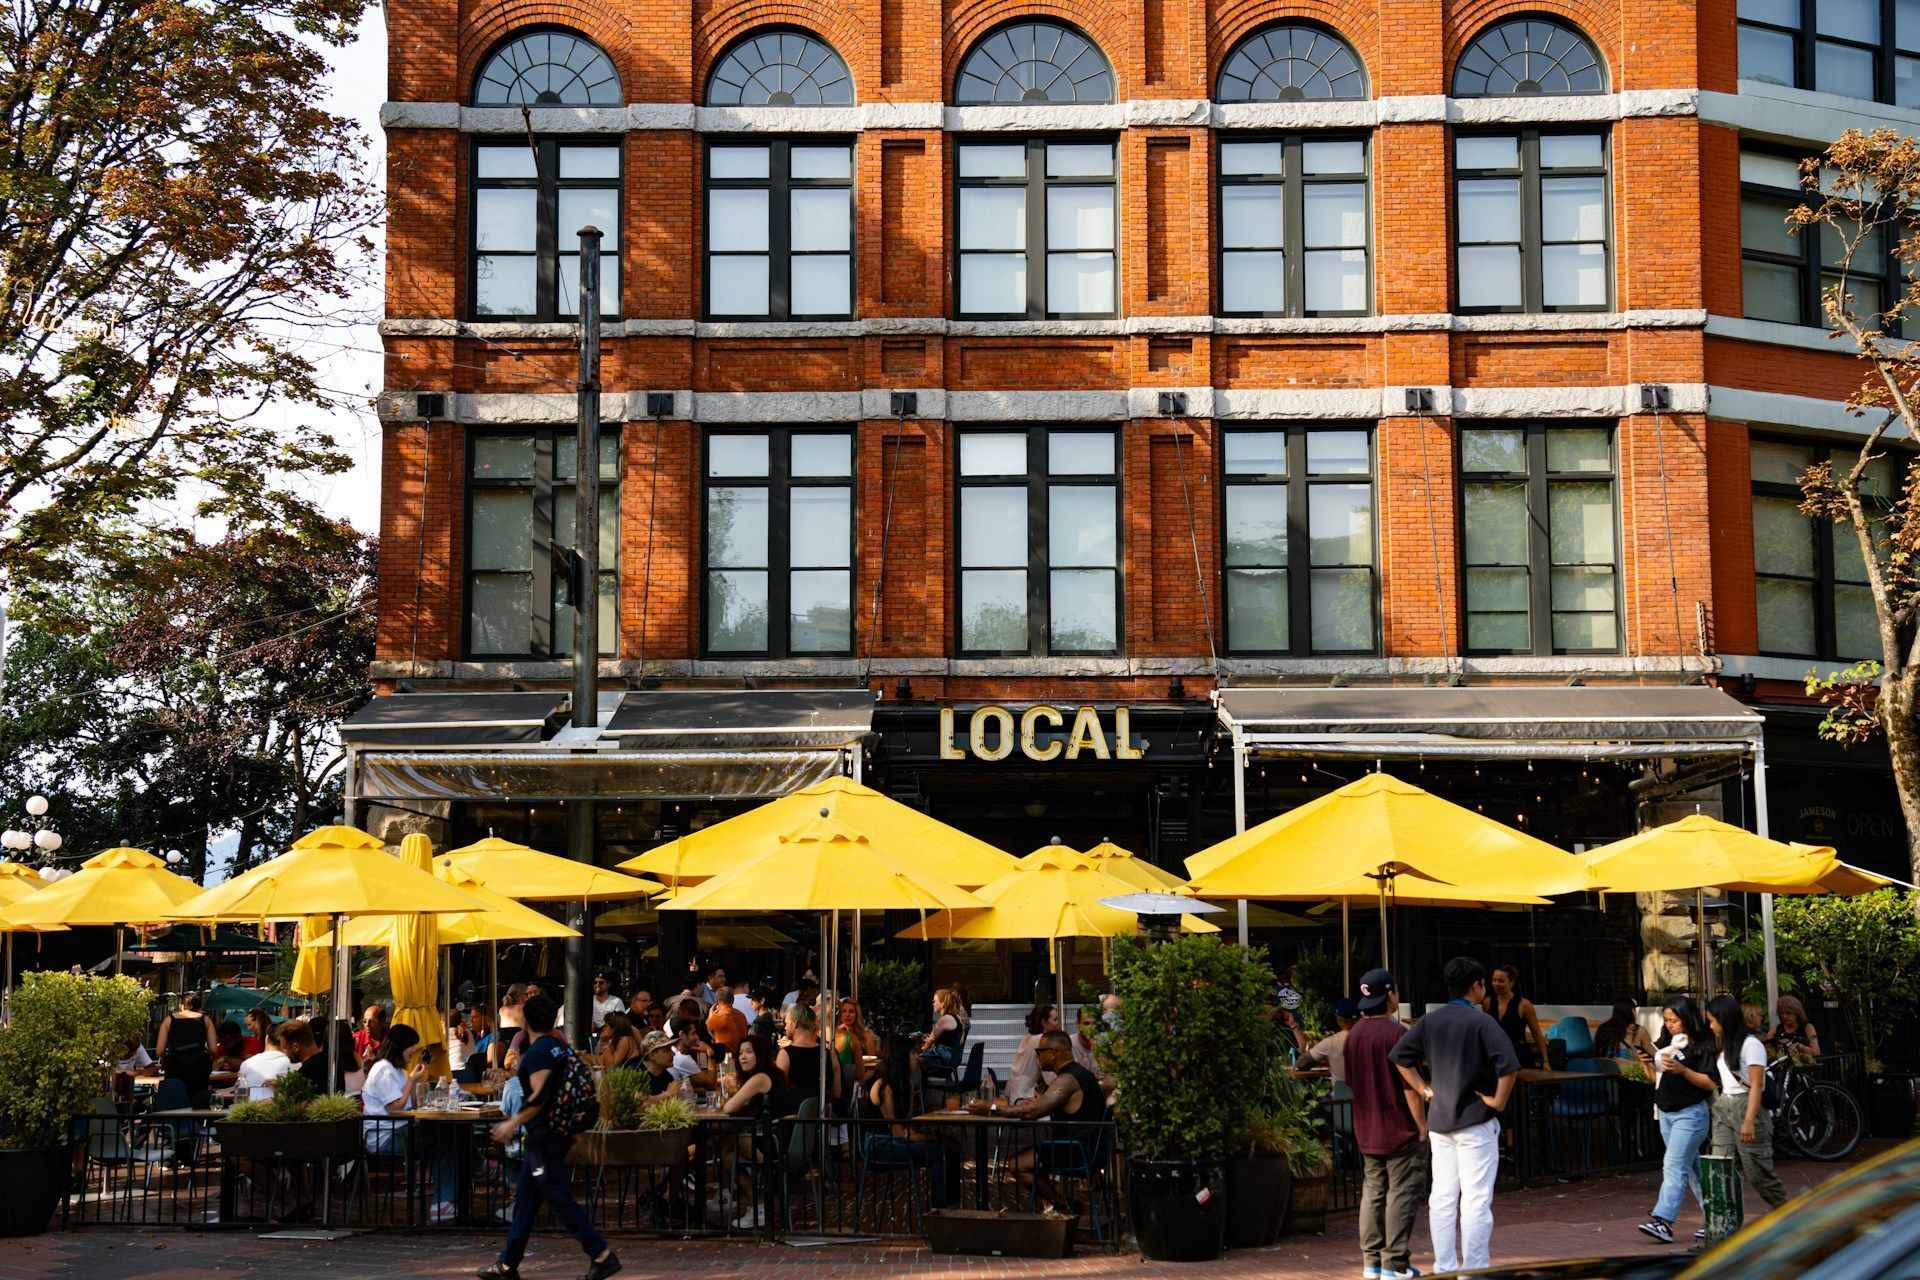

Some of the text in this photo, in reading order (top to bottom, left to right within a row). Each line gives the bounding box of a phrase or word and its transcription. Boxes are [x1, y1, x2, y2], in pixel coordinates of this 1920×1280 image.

[14, 278, 121, 341] Vibant
[939, 705, 1143, 762] LOCAL
[1799, 806, 1837, 820] JAMESON
[1847, 813, 1894, 837] OPEN
